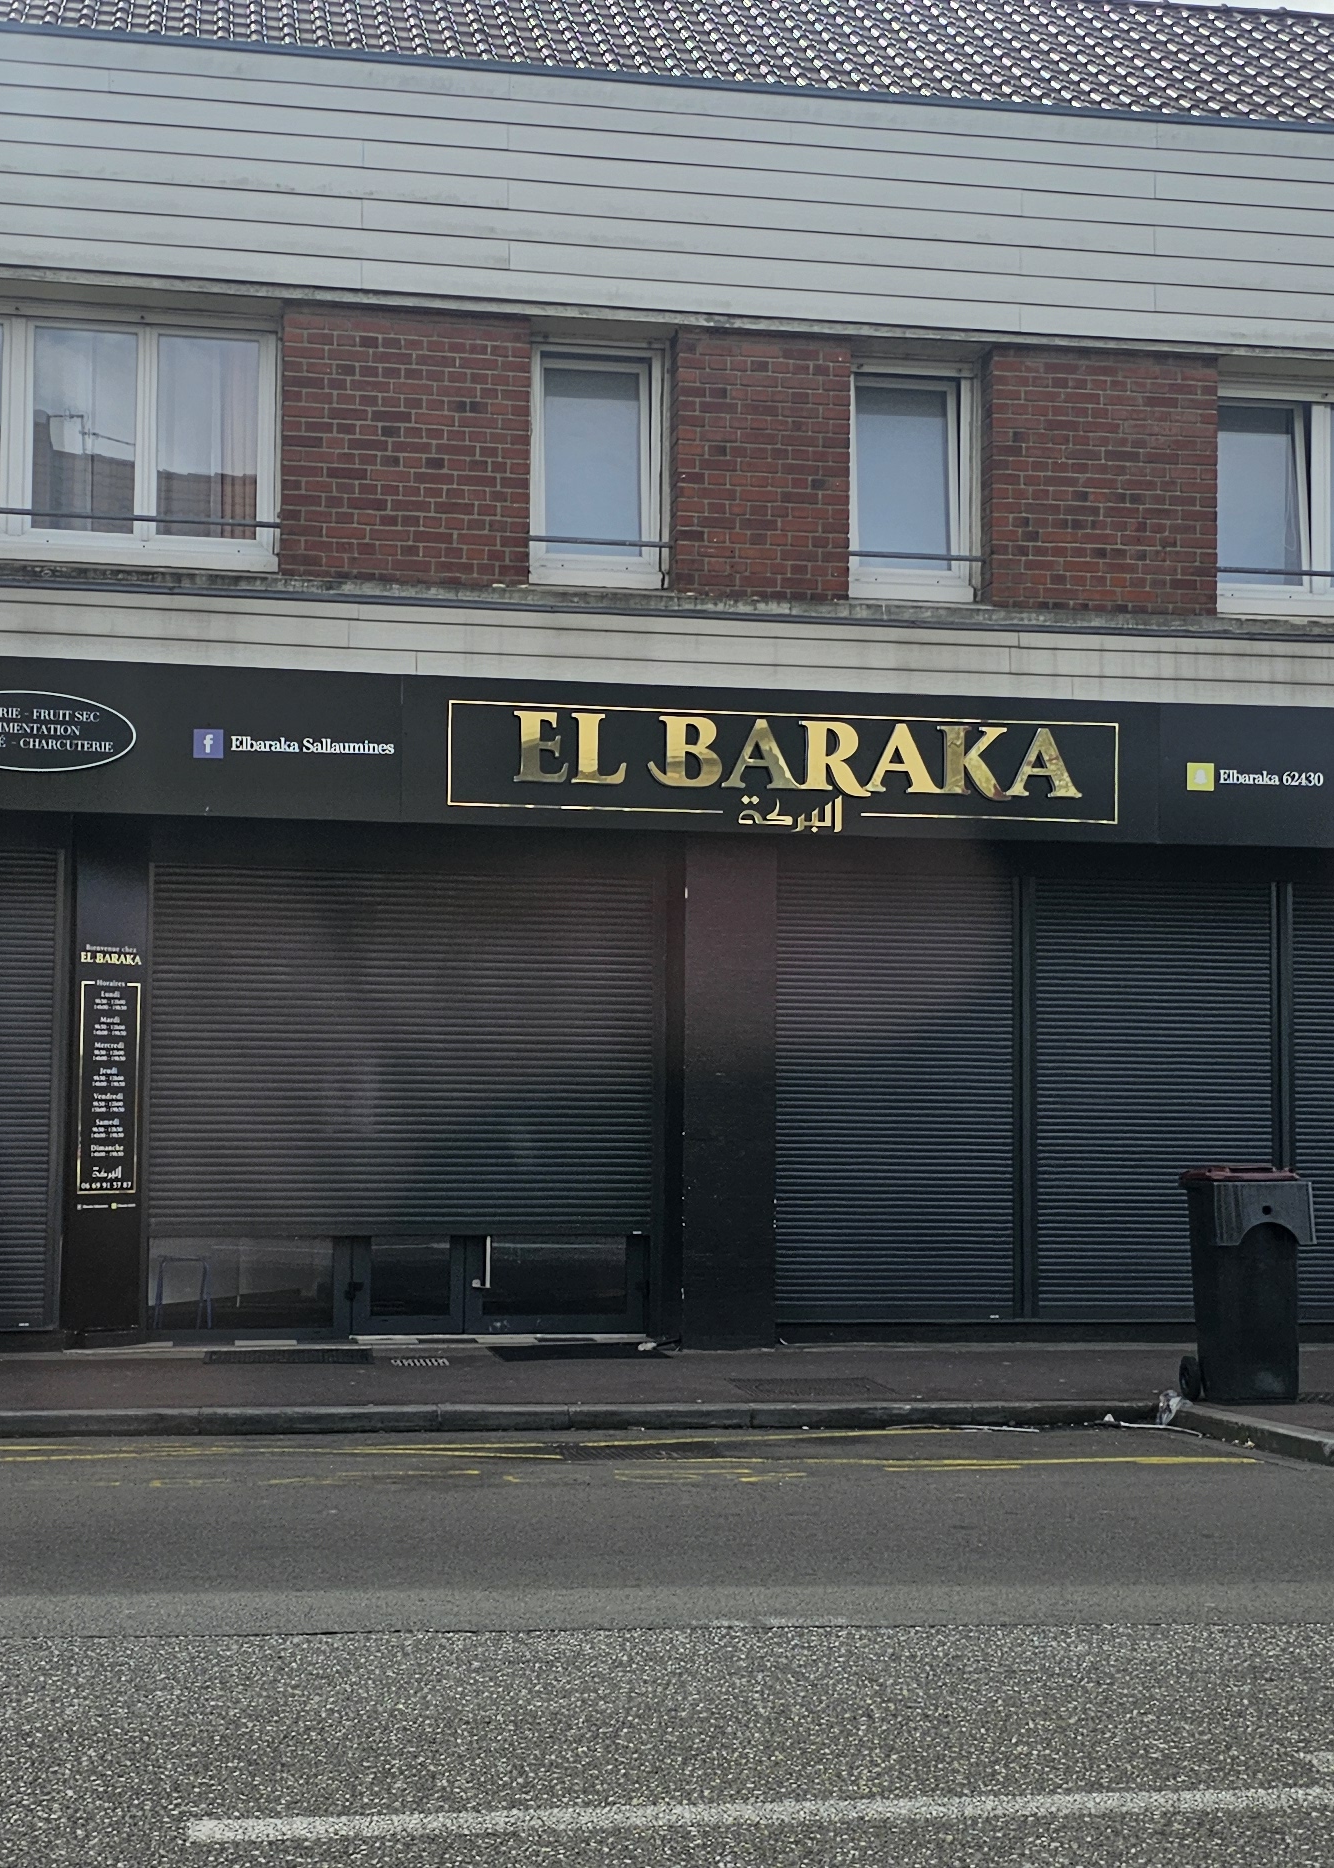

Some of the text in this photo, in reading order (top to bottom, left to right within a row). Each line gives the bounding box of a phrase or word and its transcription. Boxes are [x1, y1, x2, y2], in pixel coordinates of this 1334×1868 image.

[33, 709, 72, 721] FRUIT
[74, 711, 100, 722] SEC
[19, 737, 114, 752] CHARCUTERIE
[231, 735, 395, 755] Elbaraka Sallaumines
[513, 711, 1083, 801] EL BARAKA
[1219, 769, 1324, 786] Elbaraka 62430
[738, 795, 843, 832] البركة
[86, 943, 120, 953] Bienvenue
[80, 951, 142, 966] EL BARAKA
[97, 979, 126, 987] Horaires
[100, 990, 121, 998] Lundi
[94, 1041, 125, 1049] Mercredi
[99, 1066, 118, 1075] Jeudi
[93, 1092, 124, 1100] Vendredi
[95, 1118, 120, 1126] Samedi
[90, 1143, 124, 1151] Dimanche
